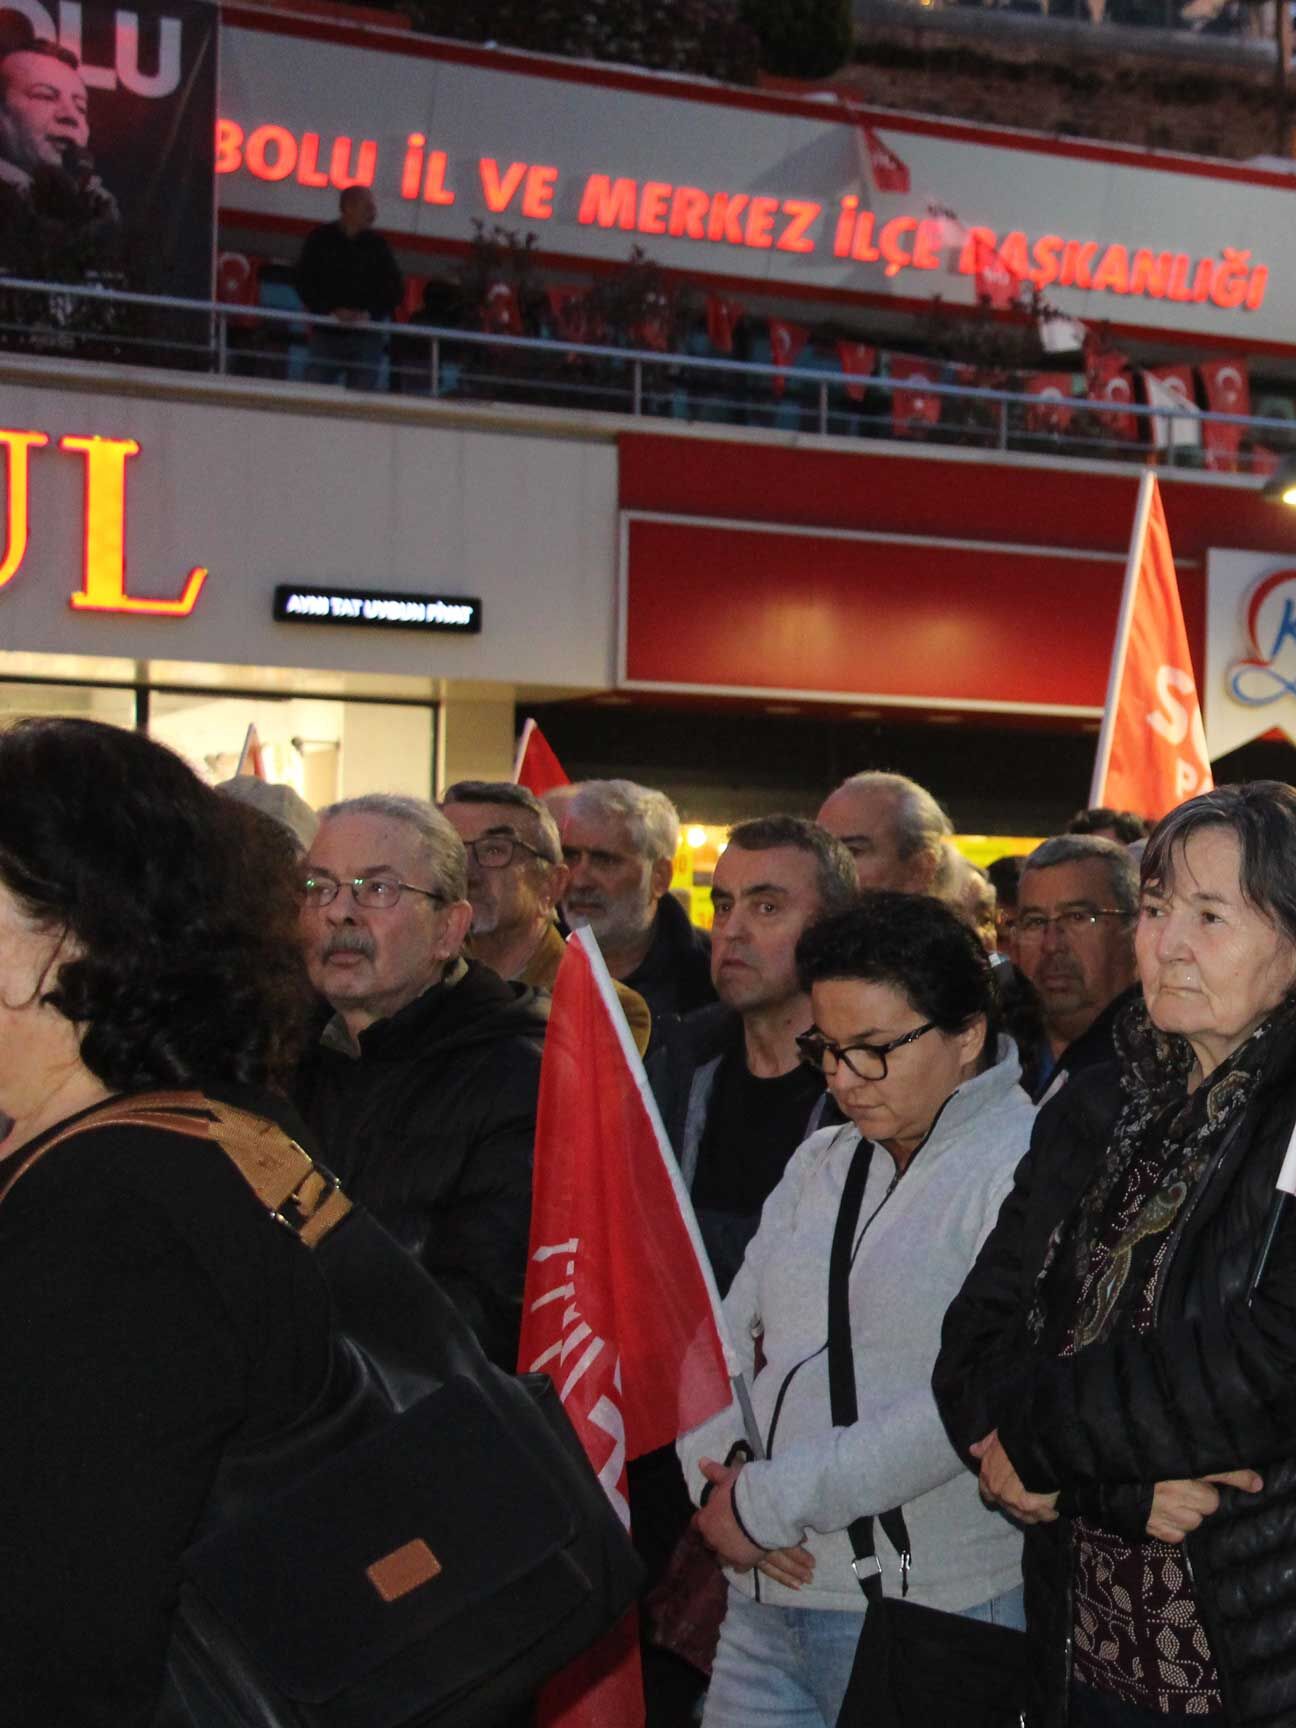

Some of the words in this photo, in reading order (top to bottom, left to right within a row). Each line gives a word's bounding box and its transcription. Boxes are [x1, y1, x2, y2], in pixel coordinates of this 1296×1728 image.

[214, 119, 377, 190] BOLU
[401, 133, 455, 205] İL
[480, 157, 558, 219] VE
[579, 173, 820, 254] MERKEZ
[834, 194, 944, 277] İLÇE
